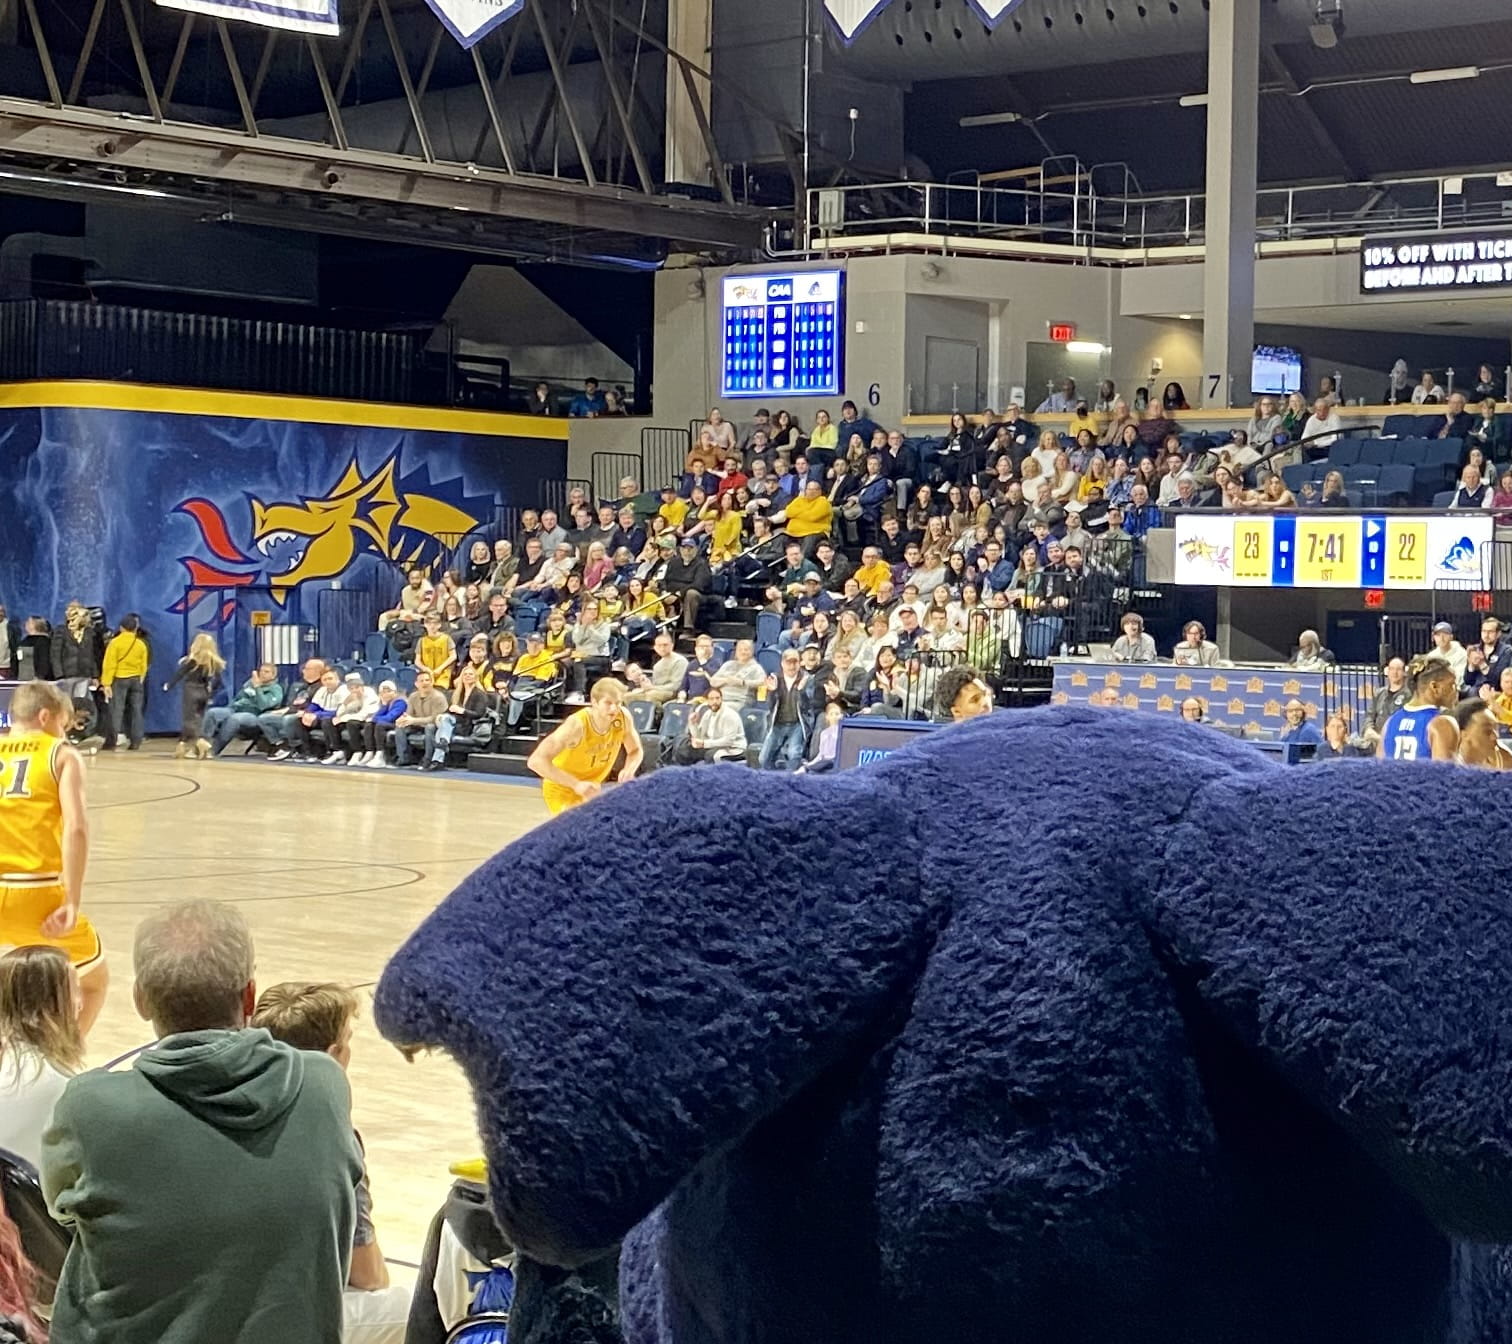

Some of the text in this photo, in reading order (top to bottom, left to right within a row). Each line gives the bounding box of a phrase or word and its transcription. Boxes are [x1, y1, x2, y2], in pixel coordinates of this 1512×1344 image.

[1364, 247, 1395, 266] 10%
[1397, 244, 1430, 265] OFF
[1432, 242, 1474, 262] WITH
[1456, 262, 1502, 284] AFTER
[868, 383, 881, 406] 6
[1208, 374, 1221, 399] 7
[1244, 532, 1260, 559] 23
[1307, 533, 1345, 563] 7:41
[1398, 533, 1416, 561] 22
